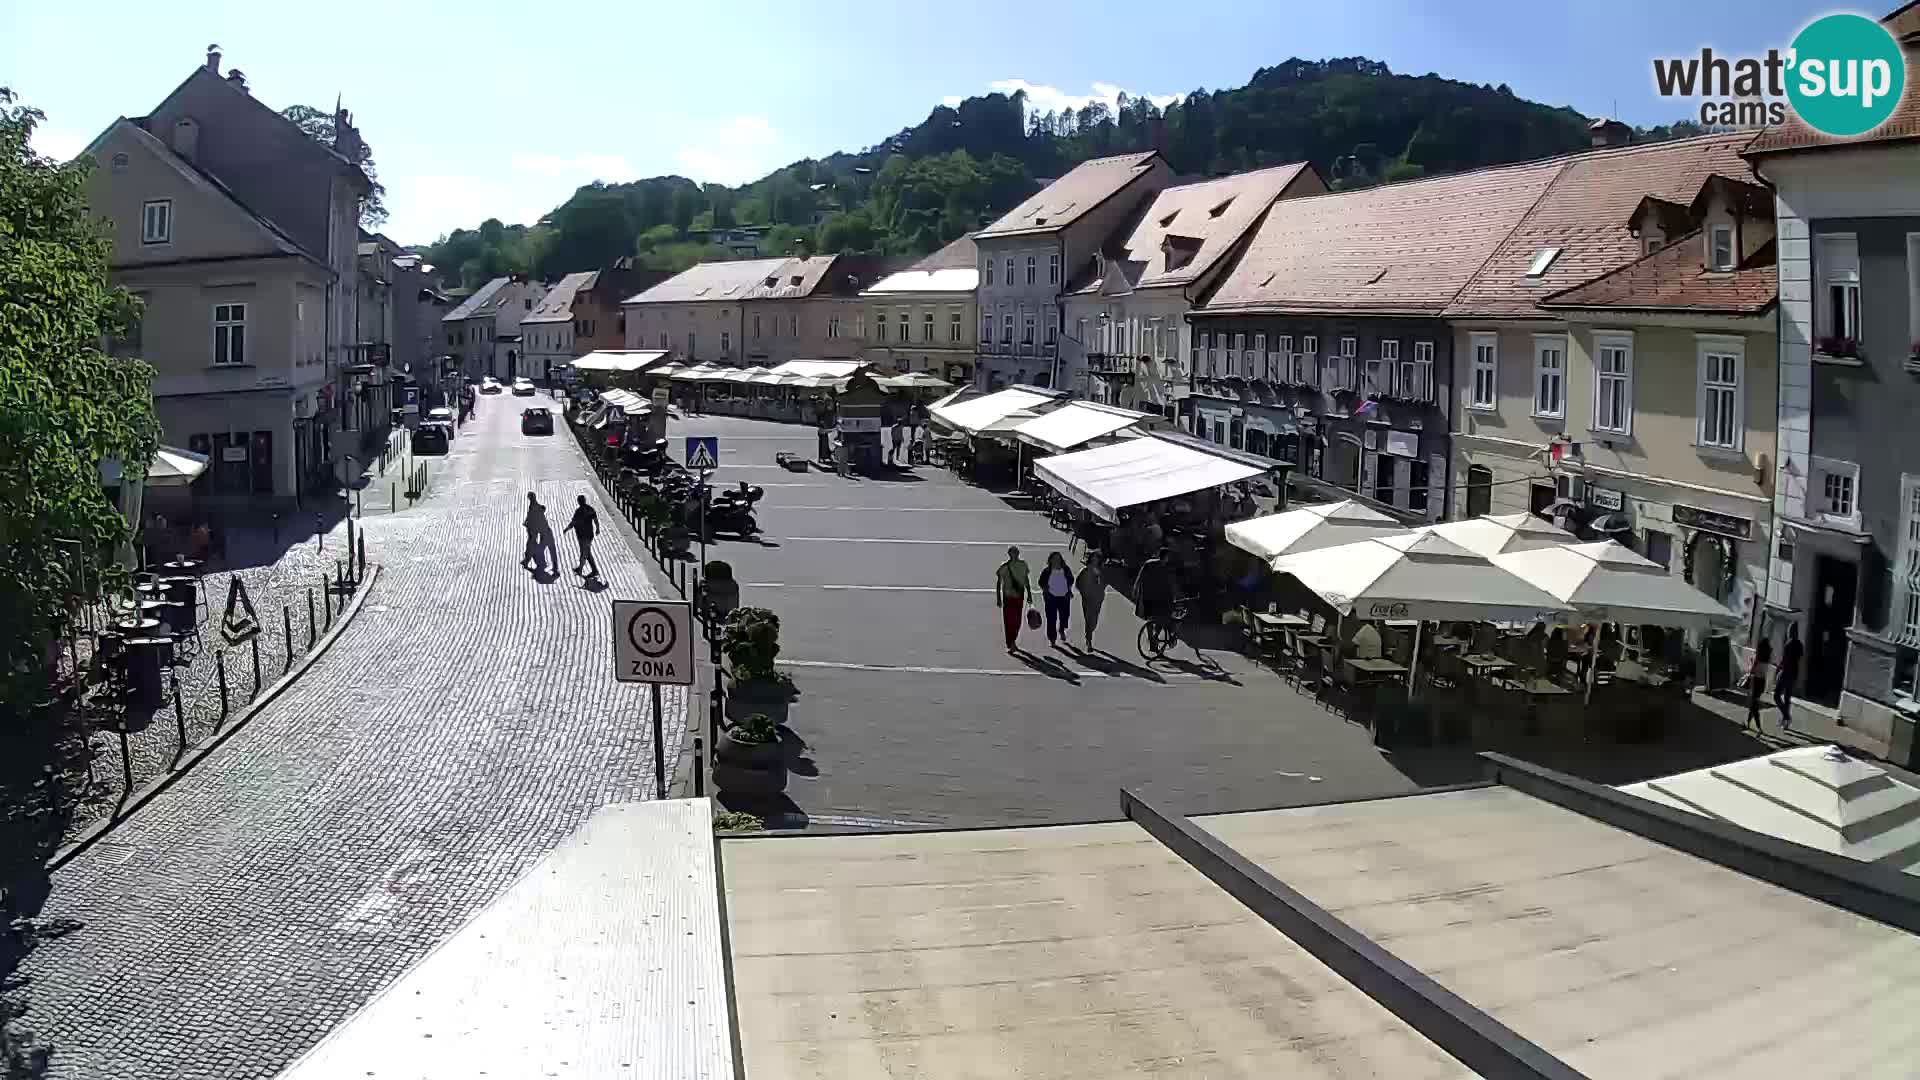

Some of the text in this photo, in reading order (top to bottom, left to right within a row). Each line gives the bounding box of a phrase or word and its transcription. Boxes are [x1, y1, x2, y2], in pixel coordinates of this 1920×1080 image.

[407, 391, 415, 402] P
[641, 622, 665, 644] 30
[631, 660, 676, 677] ZONA
